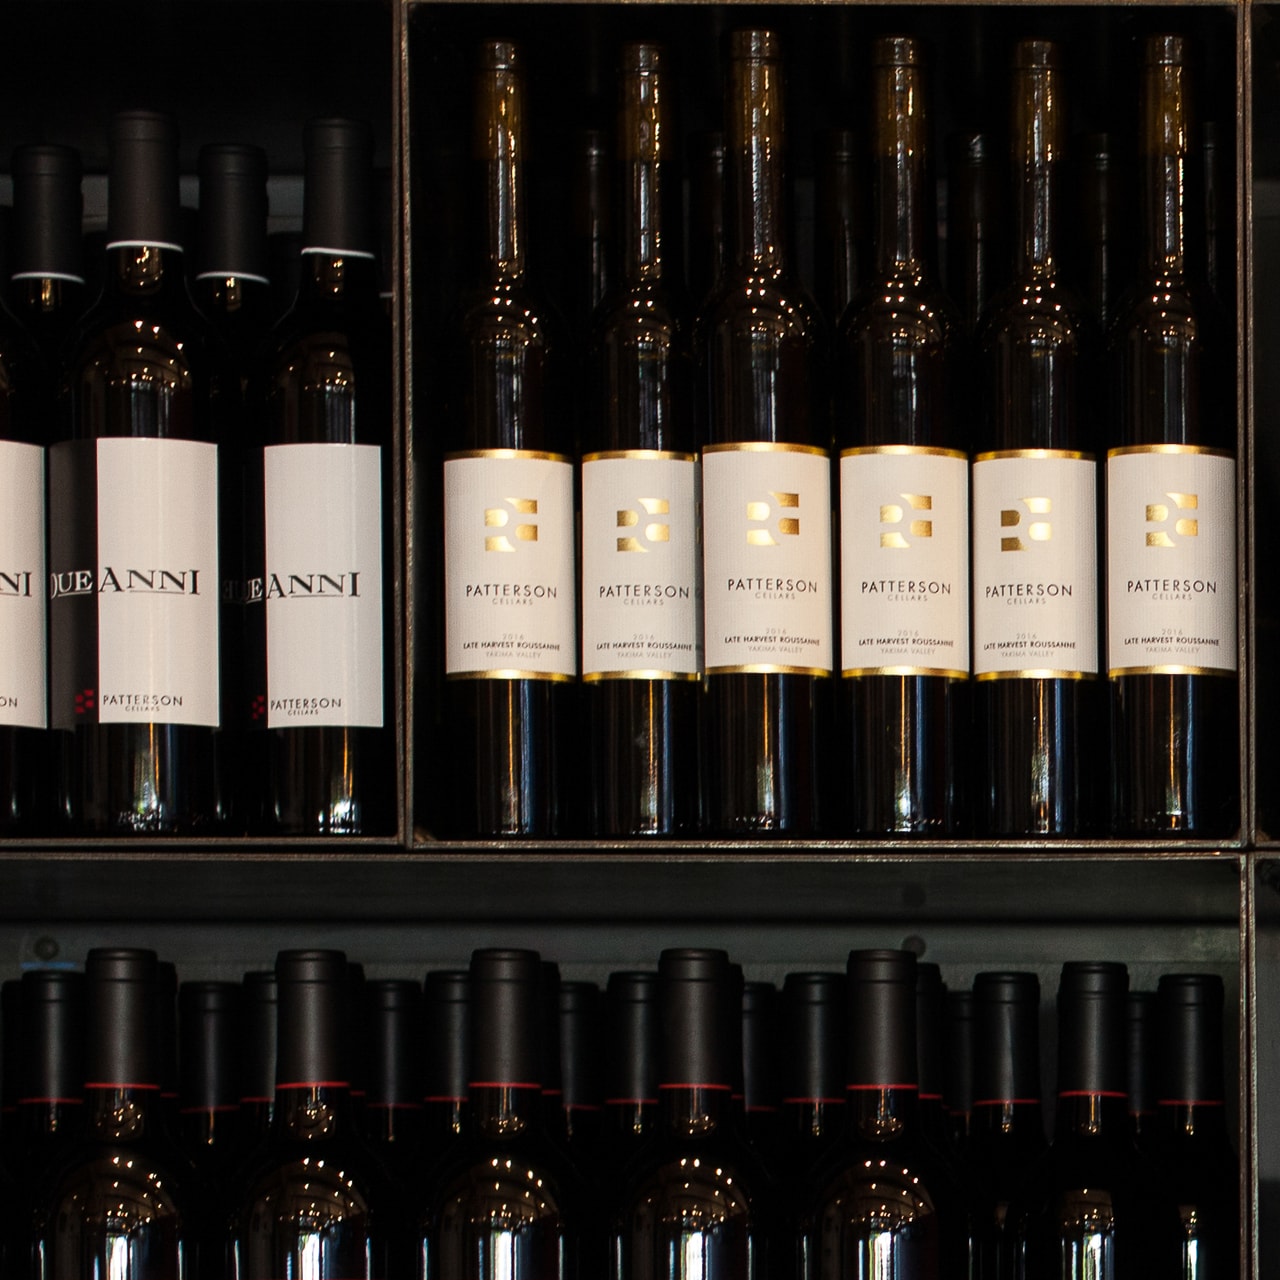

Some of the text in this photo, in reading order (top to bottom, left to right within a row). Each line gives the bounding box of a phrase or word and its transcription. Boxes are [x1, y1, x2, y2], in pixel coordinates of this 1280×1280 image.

[99, 567, 200, 596] ANNI
[267, 572, 360, 598] ANNI
[728, 578, 817, 593] PATTERSON
[861, 581, 951, 594] PATTERSON
[1128, 580, 1217, 594] PATTERSON
[466, 584, 557, 598] PATTERSON
[599, 585, 689, 599] PATTERSON
[986, 584, 1072, 598] PATTERSON
[492, 598, 533, 606] CELLARS
[624, 598, 664, 606] CELLARS
[481, 641, 514, 649] HARVEST
[103, 695, 183, 706] PATTERSON
[271, 698, 341, 710] PATTERSON
